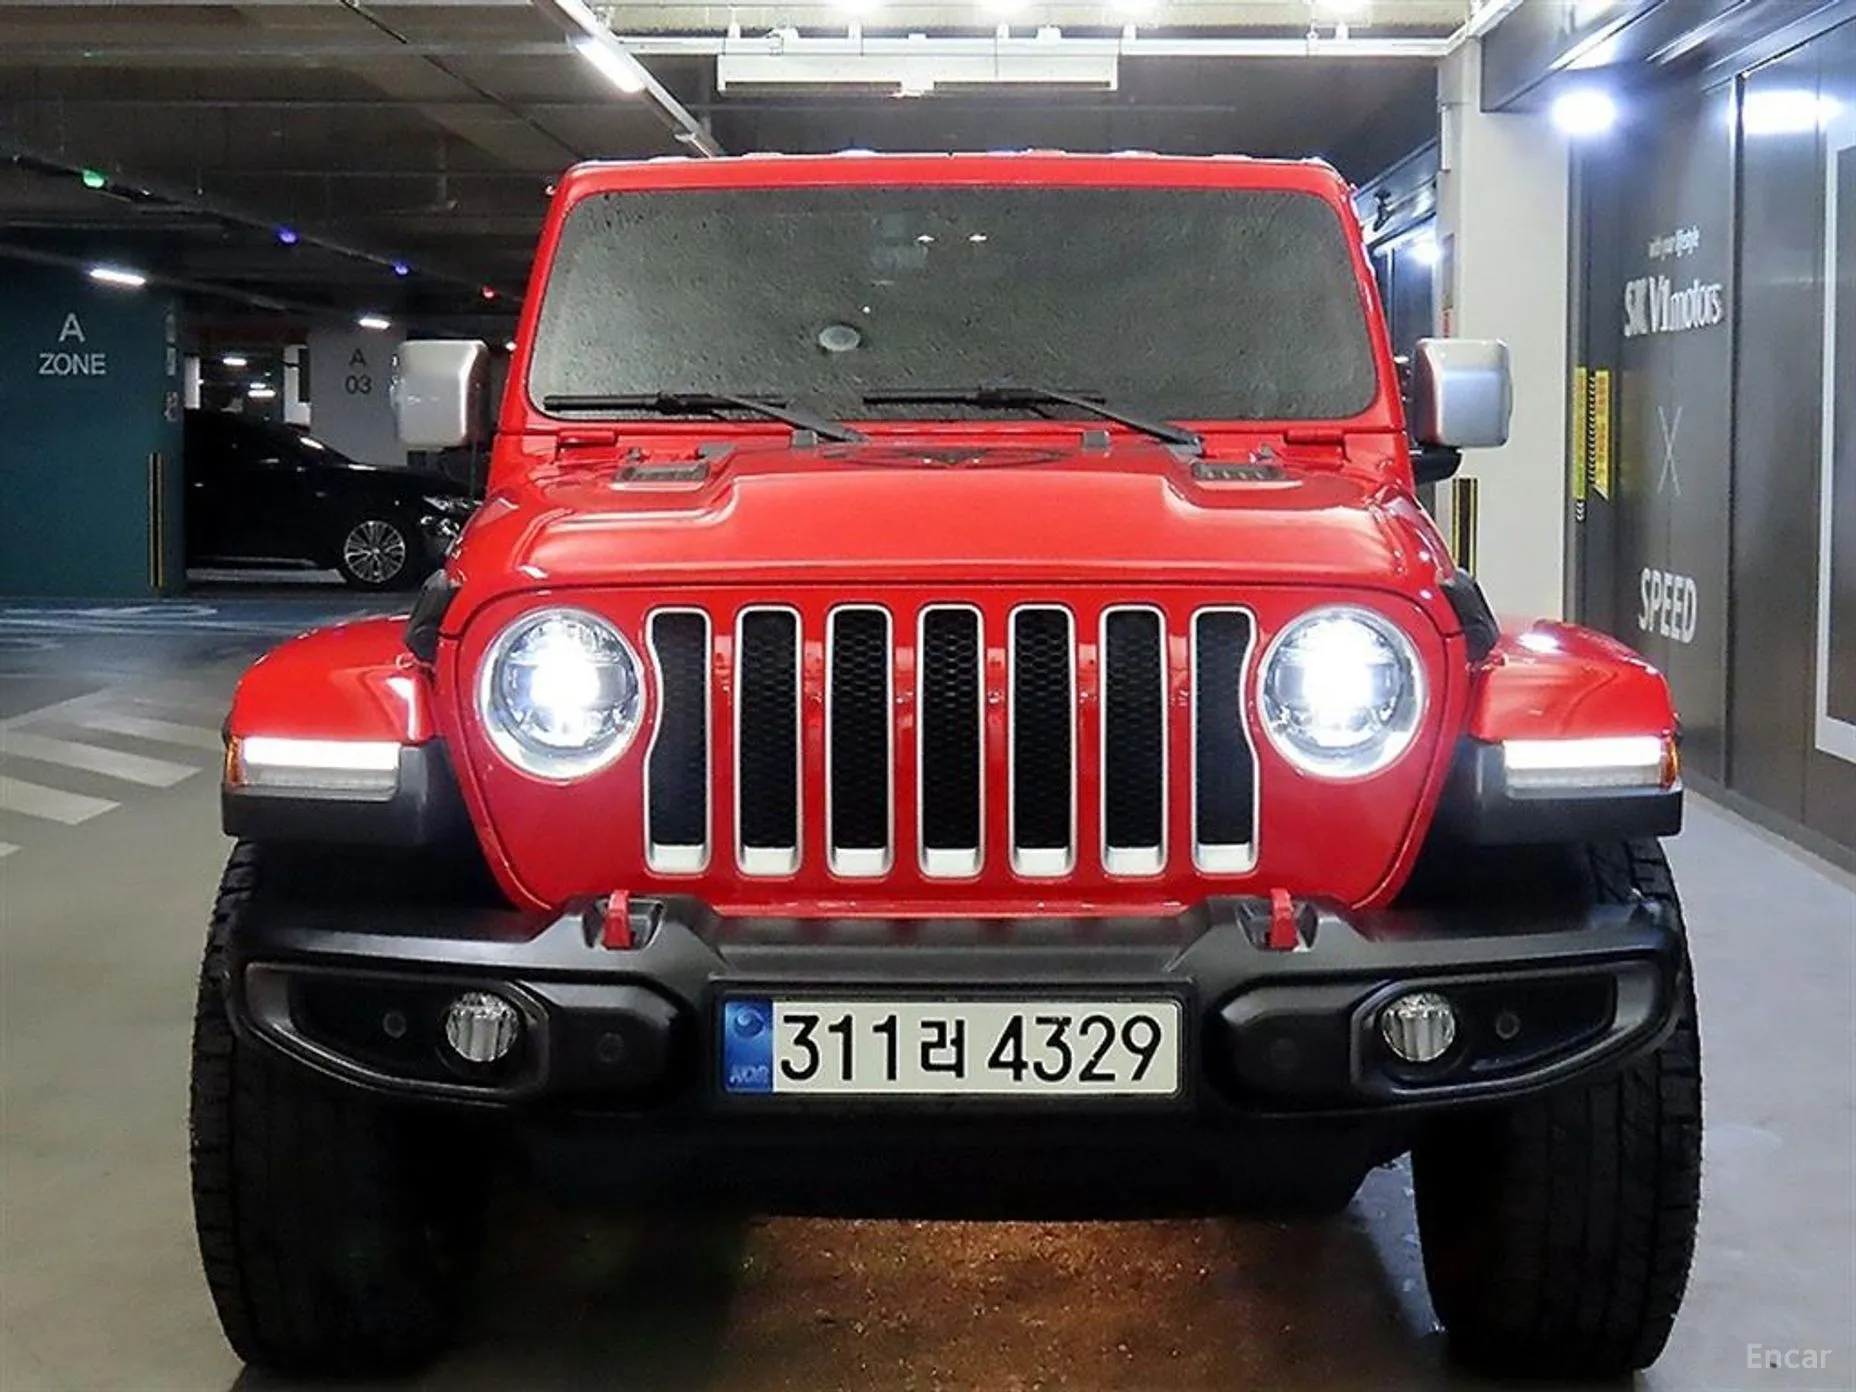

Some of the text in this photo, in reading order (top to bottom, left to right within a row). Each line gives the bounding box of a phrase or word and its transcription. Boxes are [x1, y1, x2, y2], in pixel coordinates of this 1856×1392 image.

[58, 313, 86, 343] A
[38, 352, 107, 376] ZONE
[349, 349, 367, 368] A
[345, 375, 372, 394] 03
[1638, 567, 1697, 644] SPEED
[780, 1013, 1162, 1082] 311러 4329
